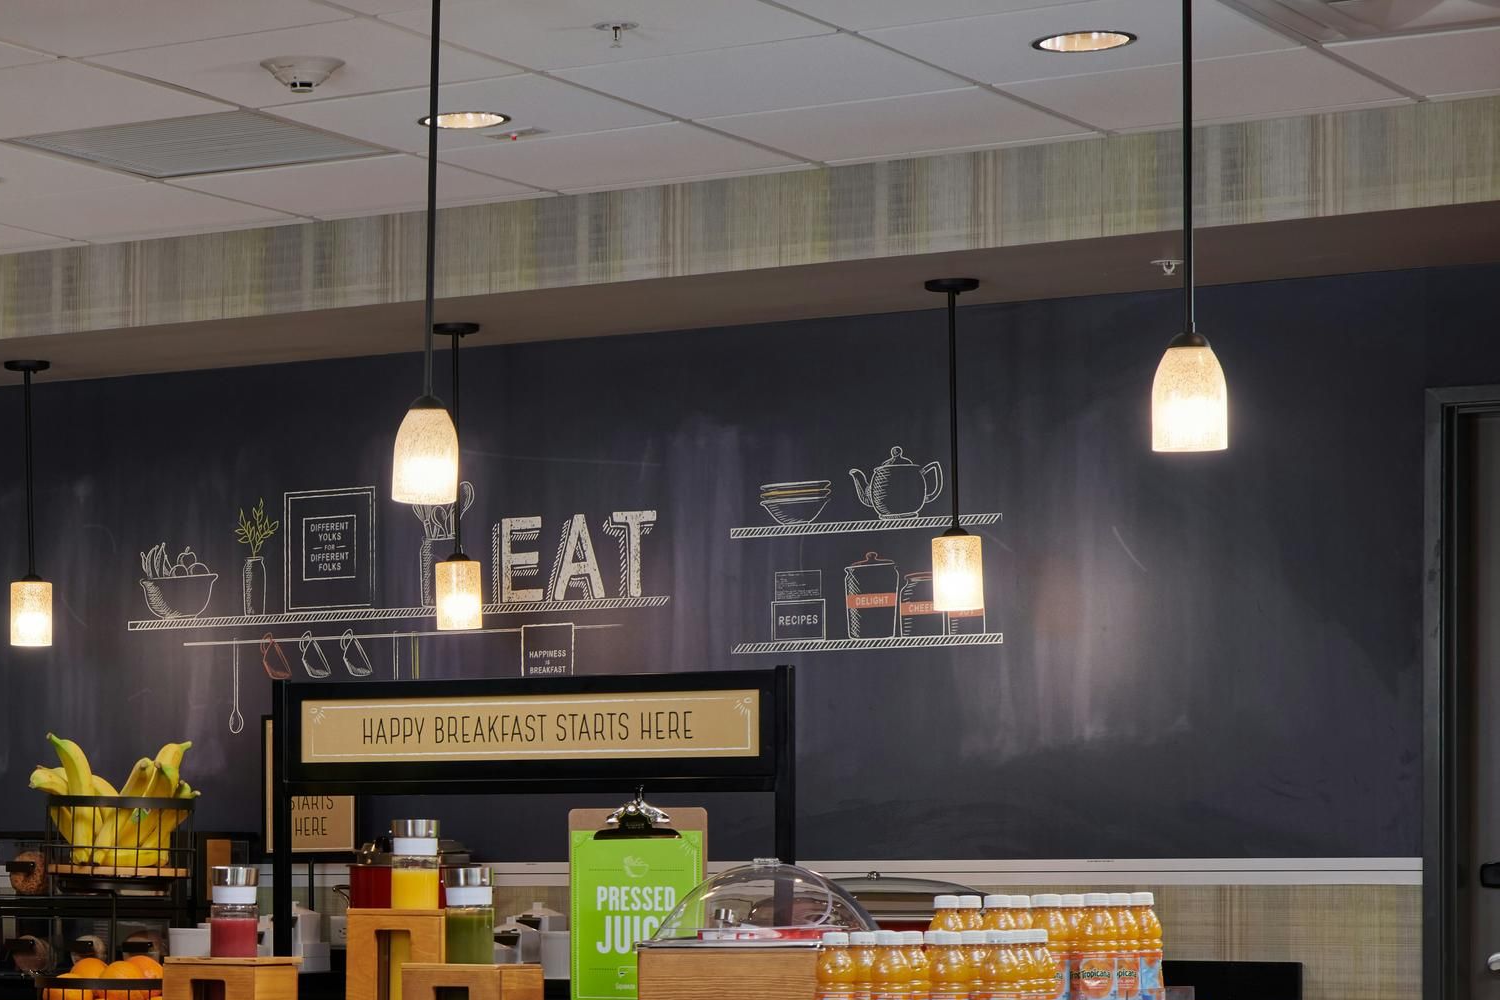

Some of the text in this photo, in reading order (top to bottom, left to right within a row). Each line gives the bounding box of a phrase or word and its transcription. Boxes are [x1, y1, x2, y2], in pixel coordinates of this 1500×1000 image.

[310, 521, 349, 533] DIFFERENT
[318, 532, 342, 542] YOLKS
[310, 551, 350, 562] DIFFERENT
[500, 509, 658, 604] EAT
[318, 562, 342, 572] FOLKS
[855, 595, 890, 606] DELIGHT
[778, 614, 819, 626] RECIPES
[528, 649, 567, 659] HAPPINESS
[529, 665, 567, 675] BREAKFAST
[362, 710, 694, 745] HAPPY BREAKFAST STARTS HERE
[294, 816, 329, 837] HERE
[596, 885, 676, 912] PRESSED
[1081, 968, 1111, 979] Tropicana
